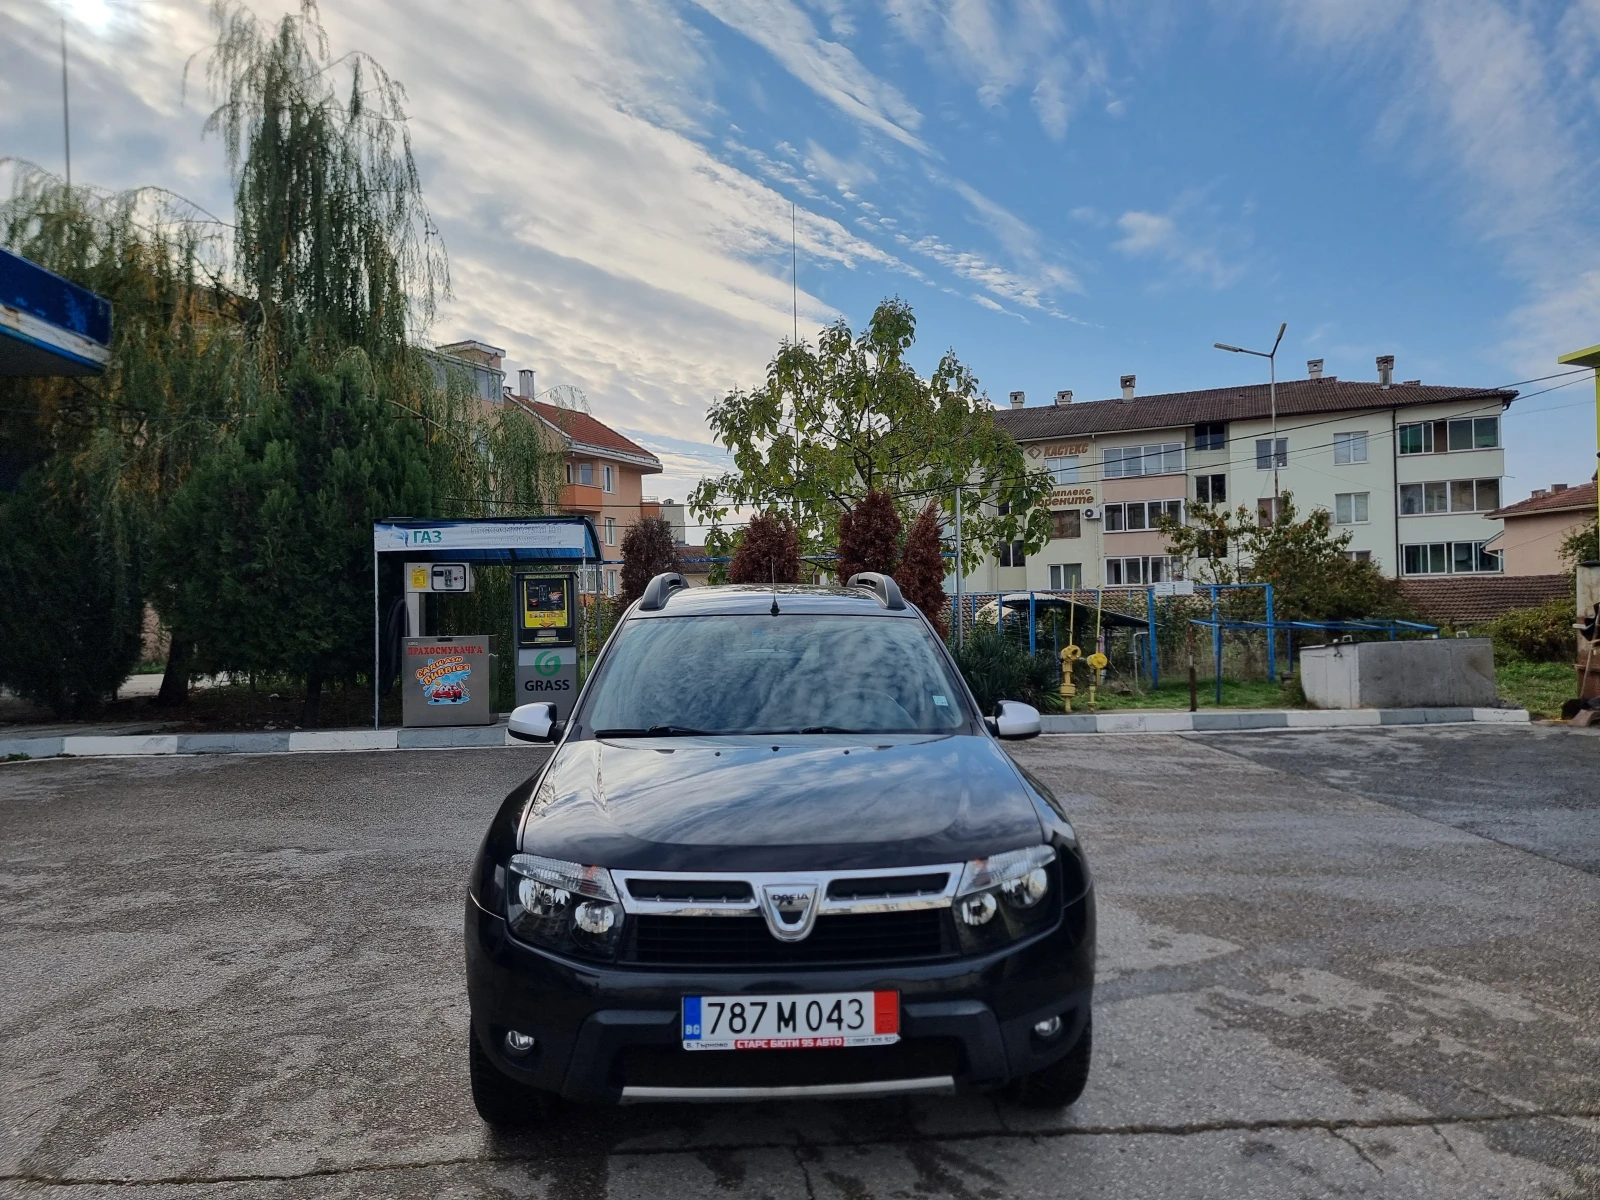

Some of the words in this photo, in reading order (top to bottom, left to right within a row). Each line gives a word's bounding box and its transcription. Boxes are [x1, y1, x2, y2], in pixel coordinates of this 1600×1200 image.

[1044, 442, 1089, 457] КАСТЕКС
[1052, 488, 1092, 497] мплекс
[412, 529, 443, 544] ГАЗ
[407, 645, 484, 656] ПРАХОСМУКАЧКА
[416, 656, 463, 678] CARWASH
[524, 679, 570, 692] GRASS
[707, 1001, 768, 1035] 787
[777, 1001, 797, 1034] M
[805, 998, 865, 1032] 043
[685, 1024, 700, 1035] BG
[737, 1039, 768, 1049] СТАРС
[770, 1038, 800, 1048] БЮТИ
[801, 1038, 814, 1047] 95
[815, 1037, 842, 1047] АВТО
